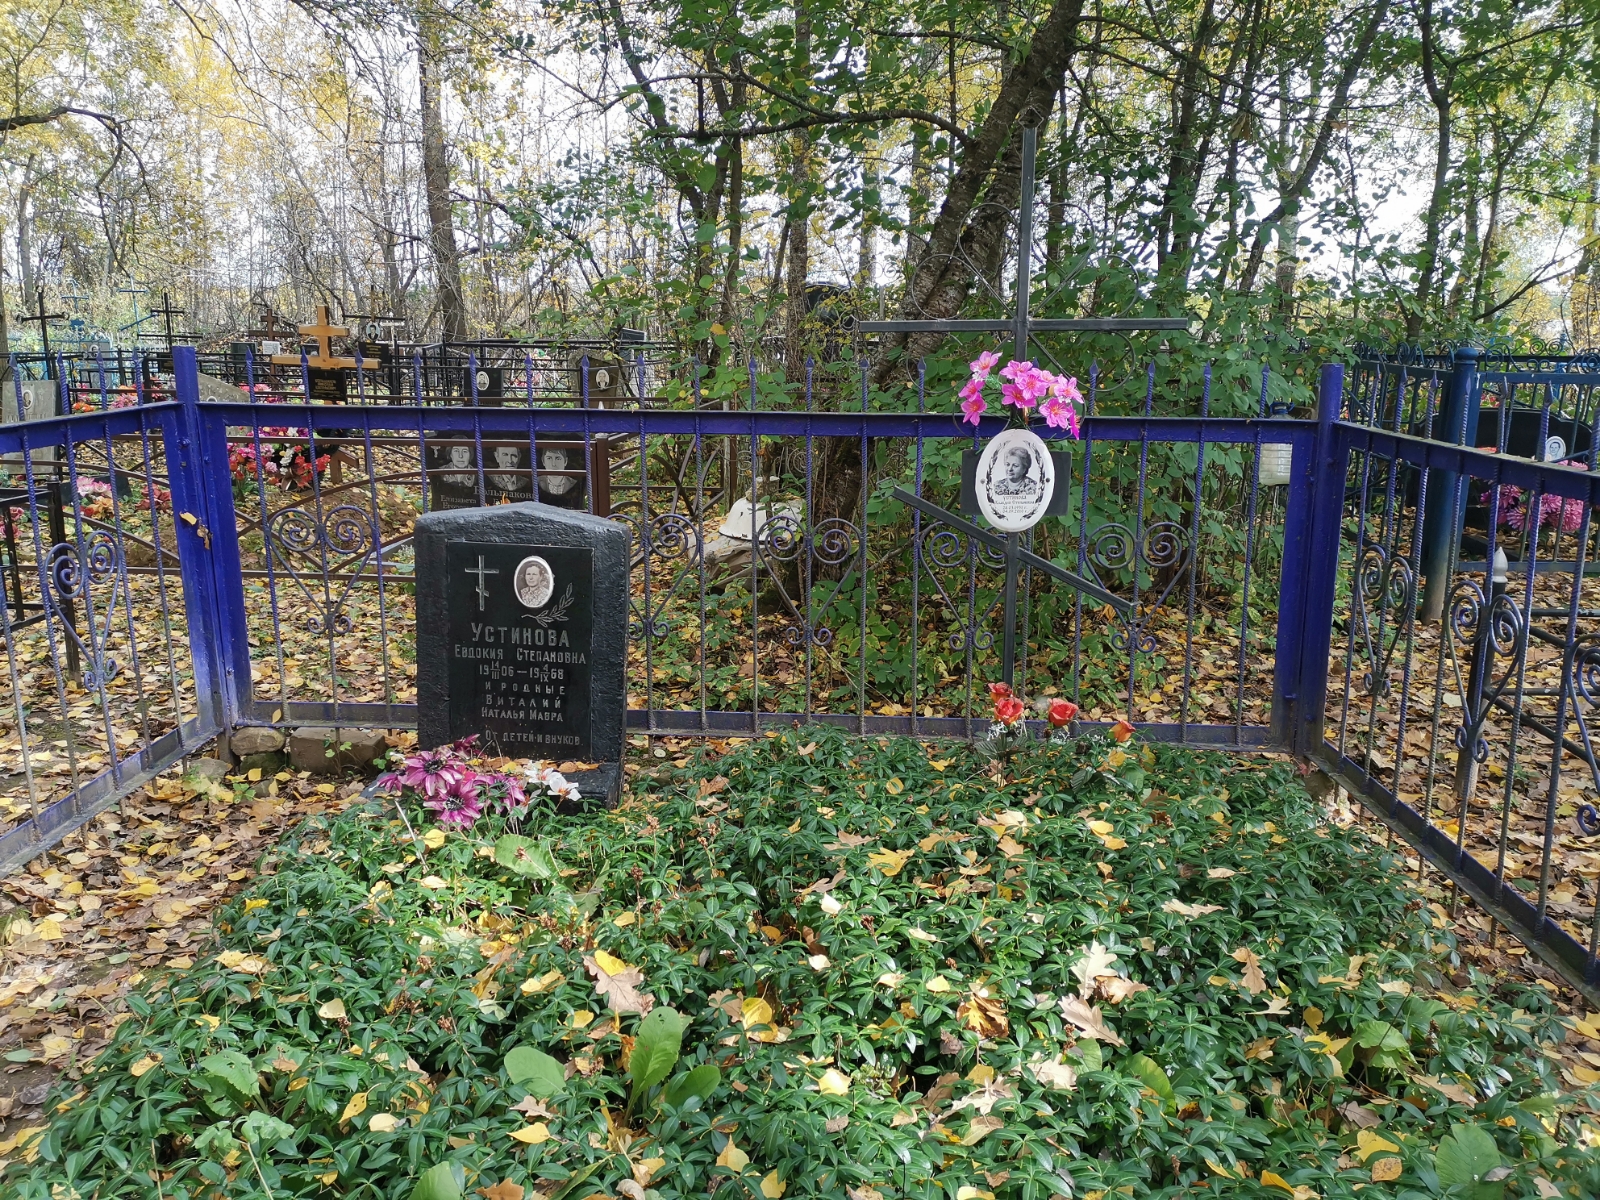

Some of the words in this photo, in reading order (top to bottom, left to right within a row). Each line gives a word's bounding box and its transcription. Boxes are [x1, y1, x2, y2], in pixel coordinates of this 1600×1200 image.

[471, 622, 570, 648] УСТИНОВА
[454, 644, 504, 660] ЕВДОКИЯ
[516, 647, 587, 664] СТЕПАНОВНА
[486, 694, 562, 709] ВИТАЛИЙ
[481, 706, 525, 720] НАТАЛЬЯ
[529, 708, 564, 722] МАВРА
[502, 730, 535, 742] ДЕТЕЙ
